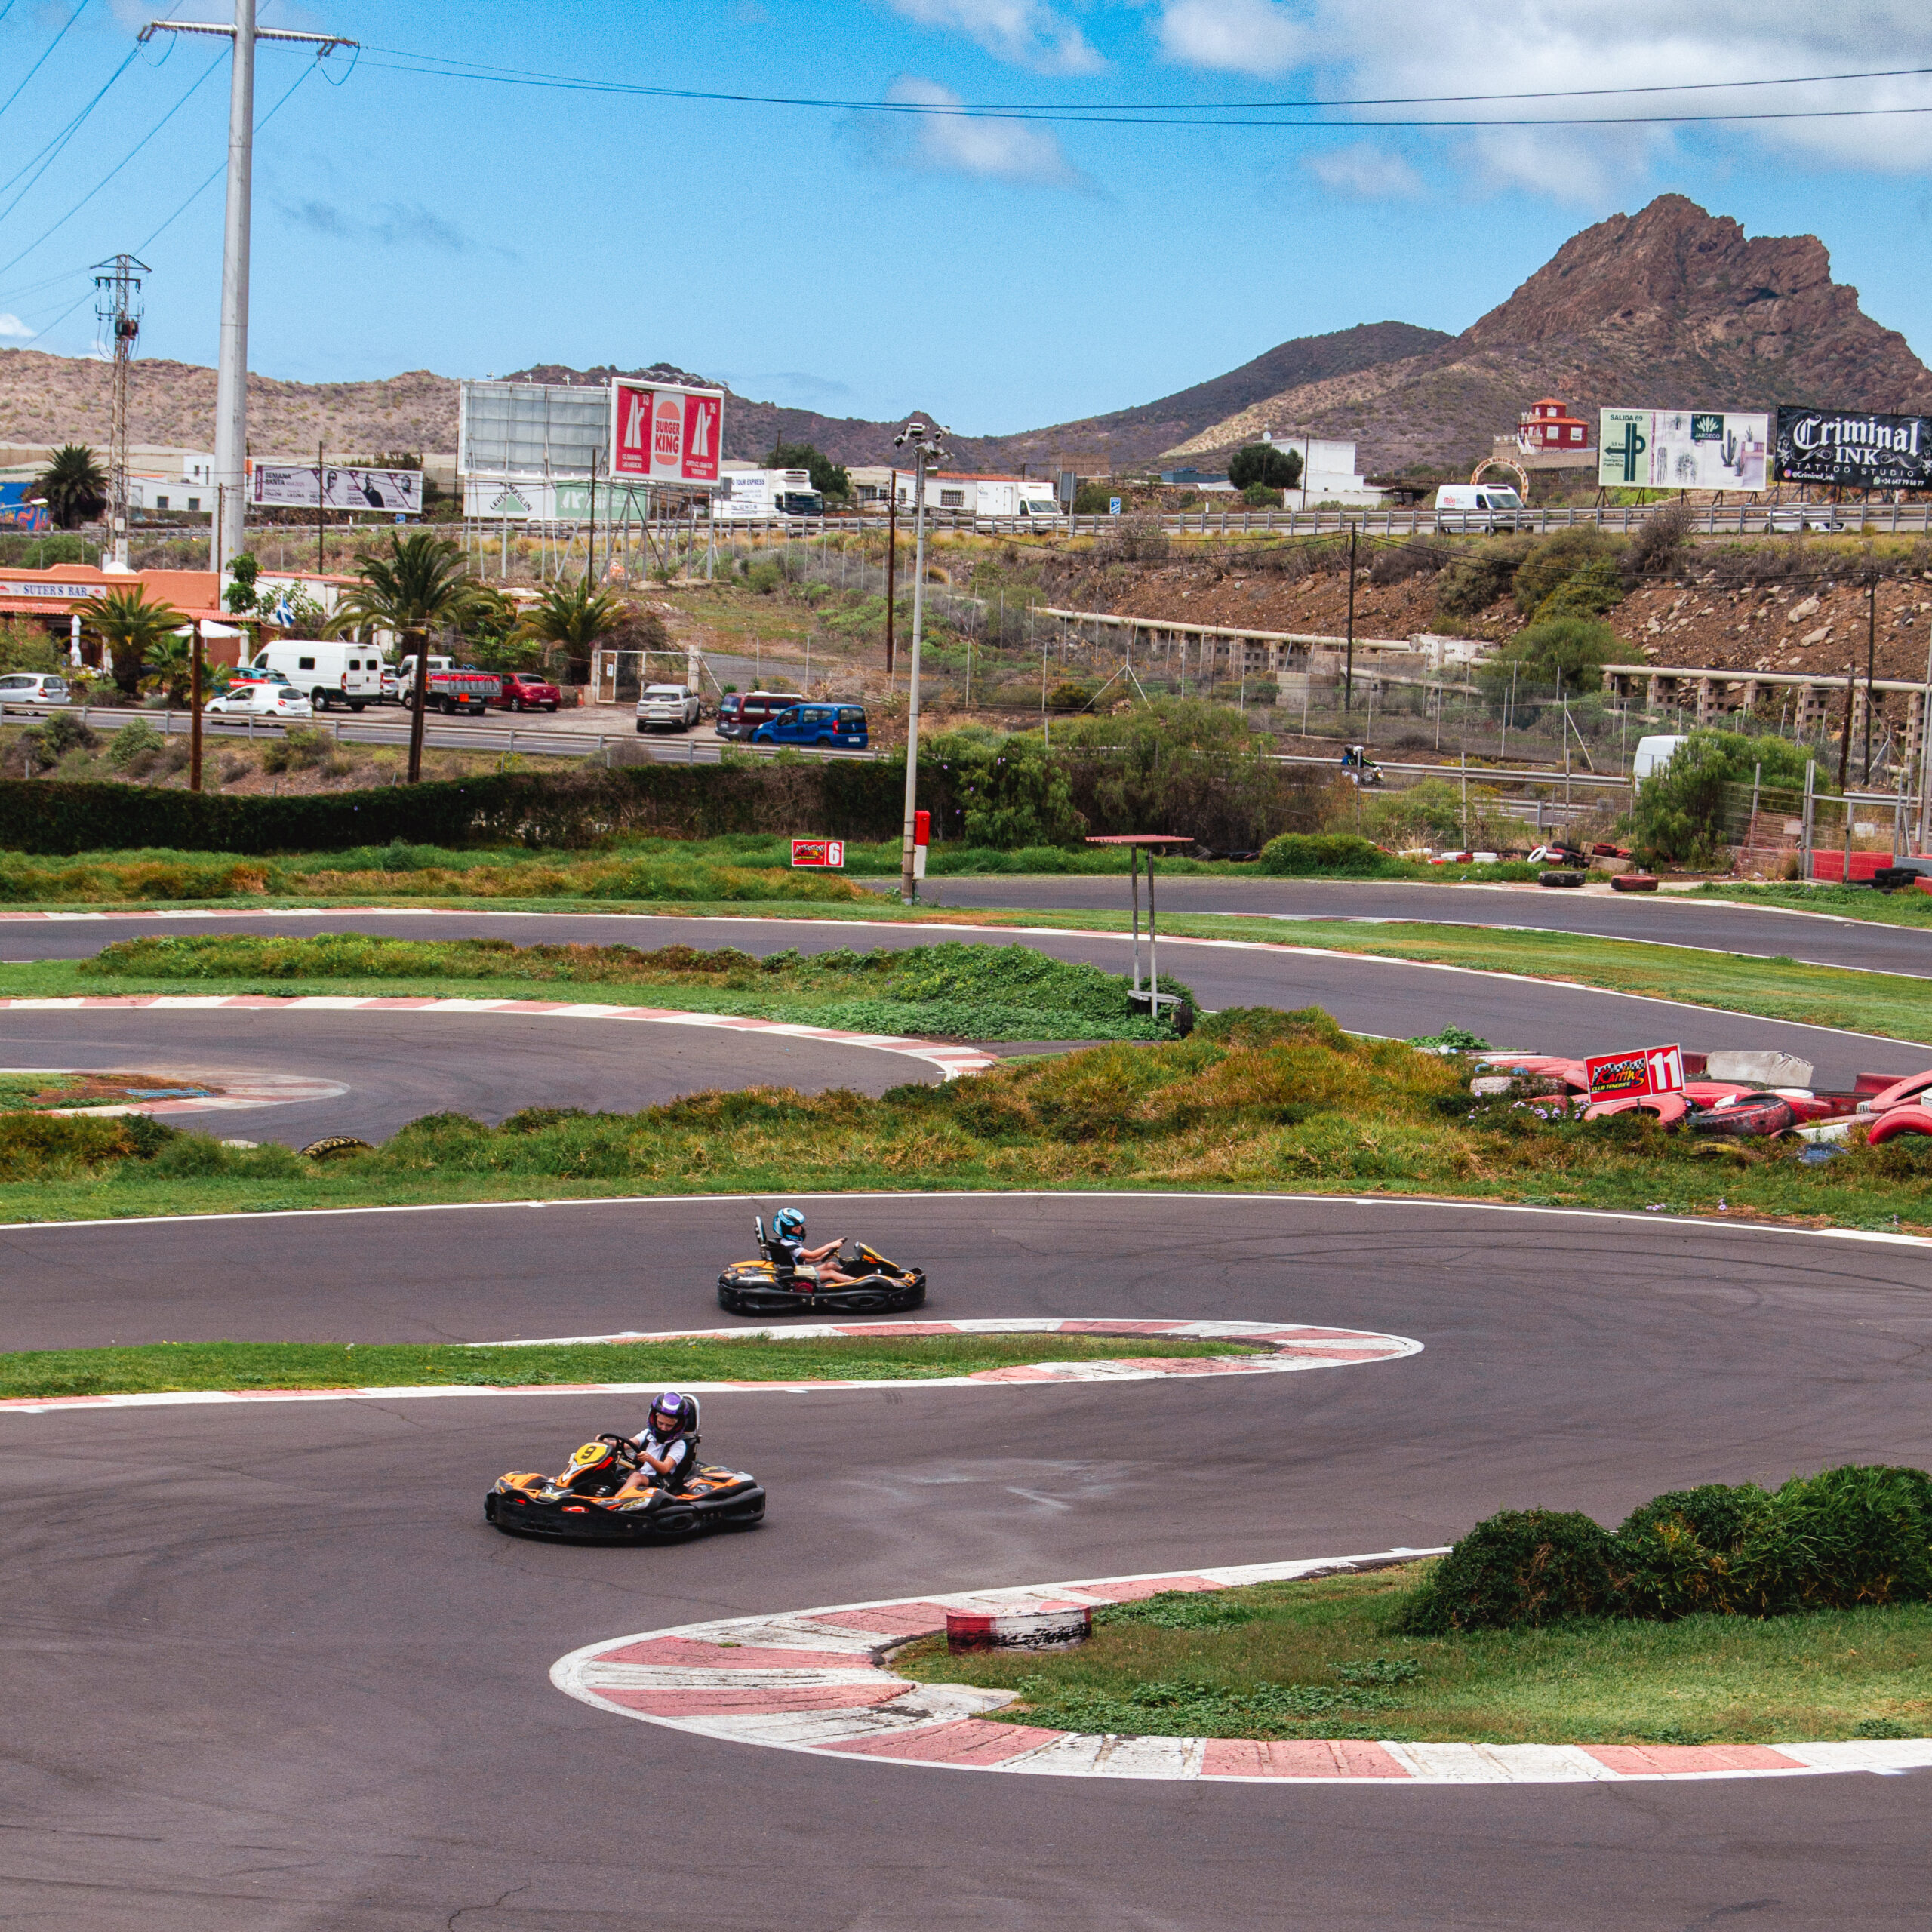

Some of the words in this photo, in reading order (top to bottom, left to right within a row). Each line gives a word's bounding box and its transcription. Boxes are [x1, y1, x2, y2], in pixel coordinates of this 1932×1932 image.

[656, 420, 681, 435] BURGER
[1793, 416, 1920, 457] Criminal
[655, 434, 679, 454] KING
[1834, 446, 1880, 466] INK
[1792, 471, 1835, 481] @Criminal_ink
[1795, 462, 1850, 474] TATTOO
[1861, 467, 1914, 478] STUDIO
[68, 586, 88, 597] BAR
[829, 842, 841, 865] 6
[1597, 1066, 1644, 1087] Karting
[1648, 1050, 1682, 1091] 11
[580, 1445, 598, 1460] 9
